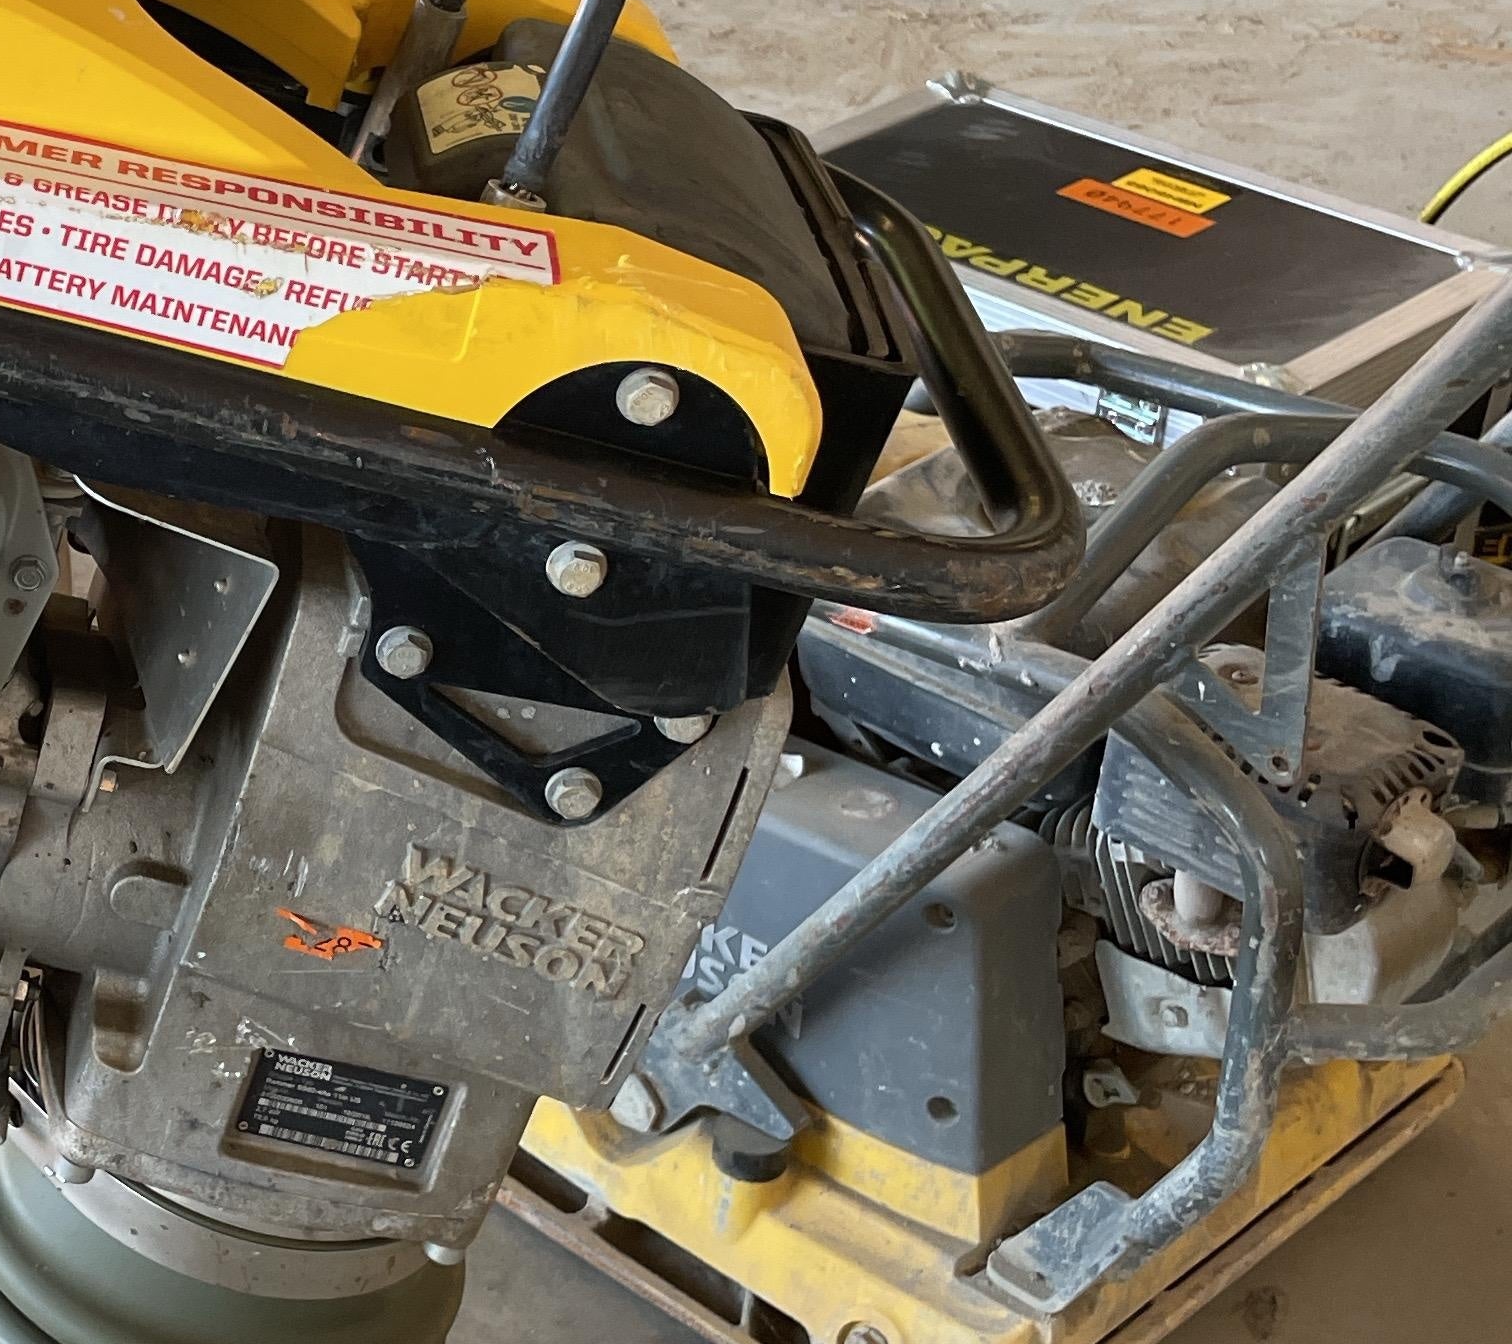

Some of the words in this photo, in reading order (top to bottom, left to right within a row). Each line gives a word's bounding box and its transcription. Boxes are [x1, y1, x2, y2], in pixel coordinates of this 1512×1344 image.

[32, 177, 148, 218] GREASE
[252, 222, 366, 269] BEFORE
[117, 159, 540, 258] RESPONSIBILITY
[59, 223, 130, 261] TIRE
[135, 243, 266, 293] DAMAGE
[377, 878, 631, 1001] NEUSON
[405, 841, 646, 958] WACKER
[274, 1061, 333, 1082] NEUSON
[277, 1053, 334, 1073] WACKER
